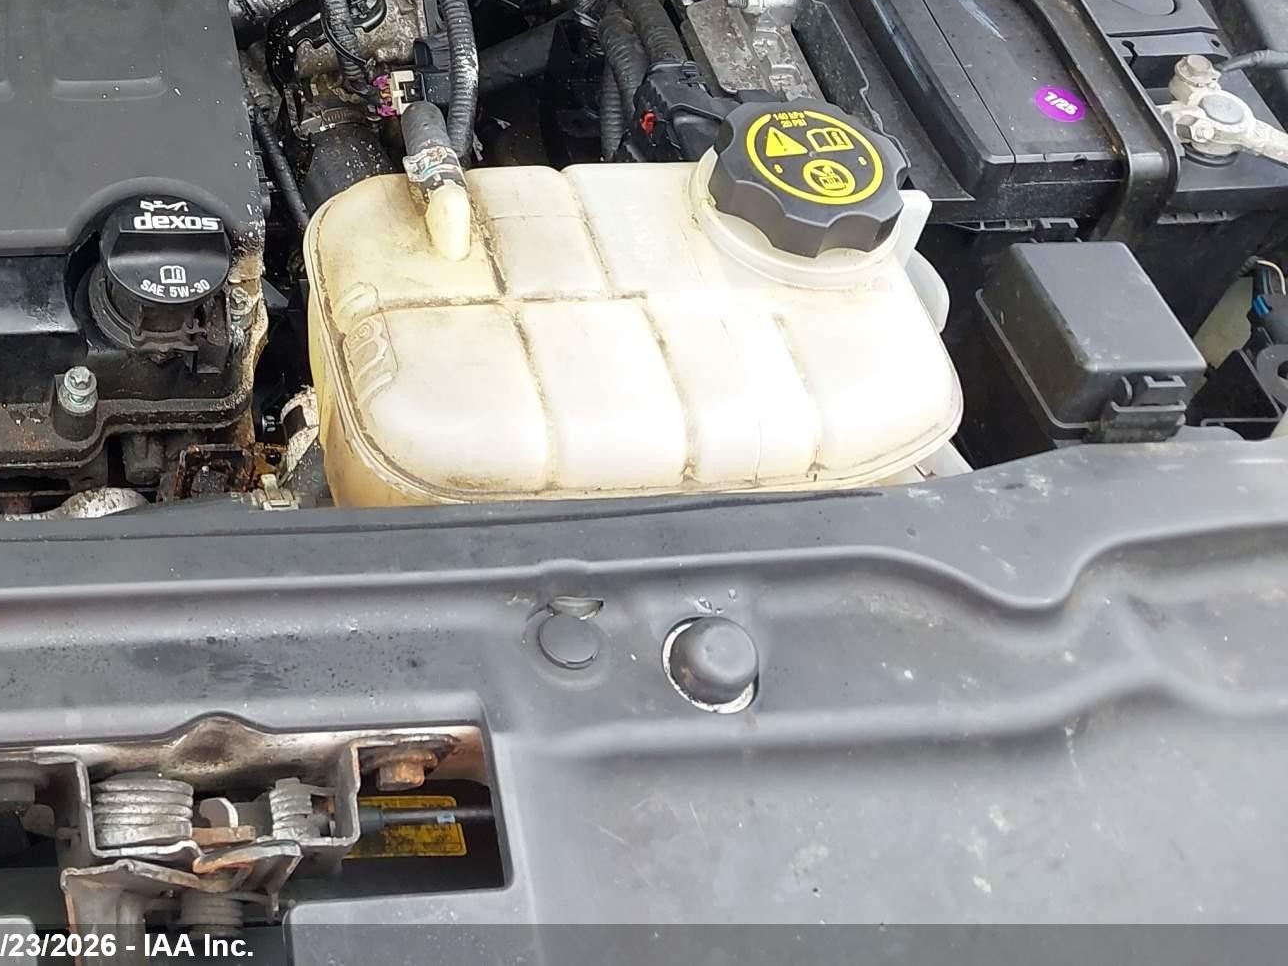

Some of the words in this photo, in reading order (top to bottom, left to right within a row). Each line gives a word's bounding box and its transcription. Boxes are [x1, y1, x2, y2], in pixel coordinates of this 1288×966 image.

[1044, 91, 1078, 115] 7/25
[133, 212, 221, 231] dexos
[140, 279, 166, 298] SAE
[169, 279, 211, 298] 5W-30
